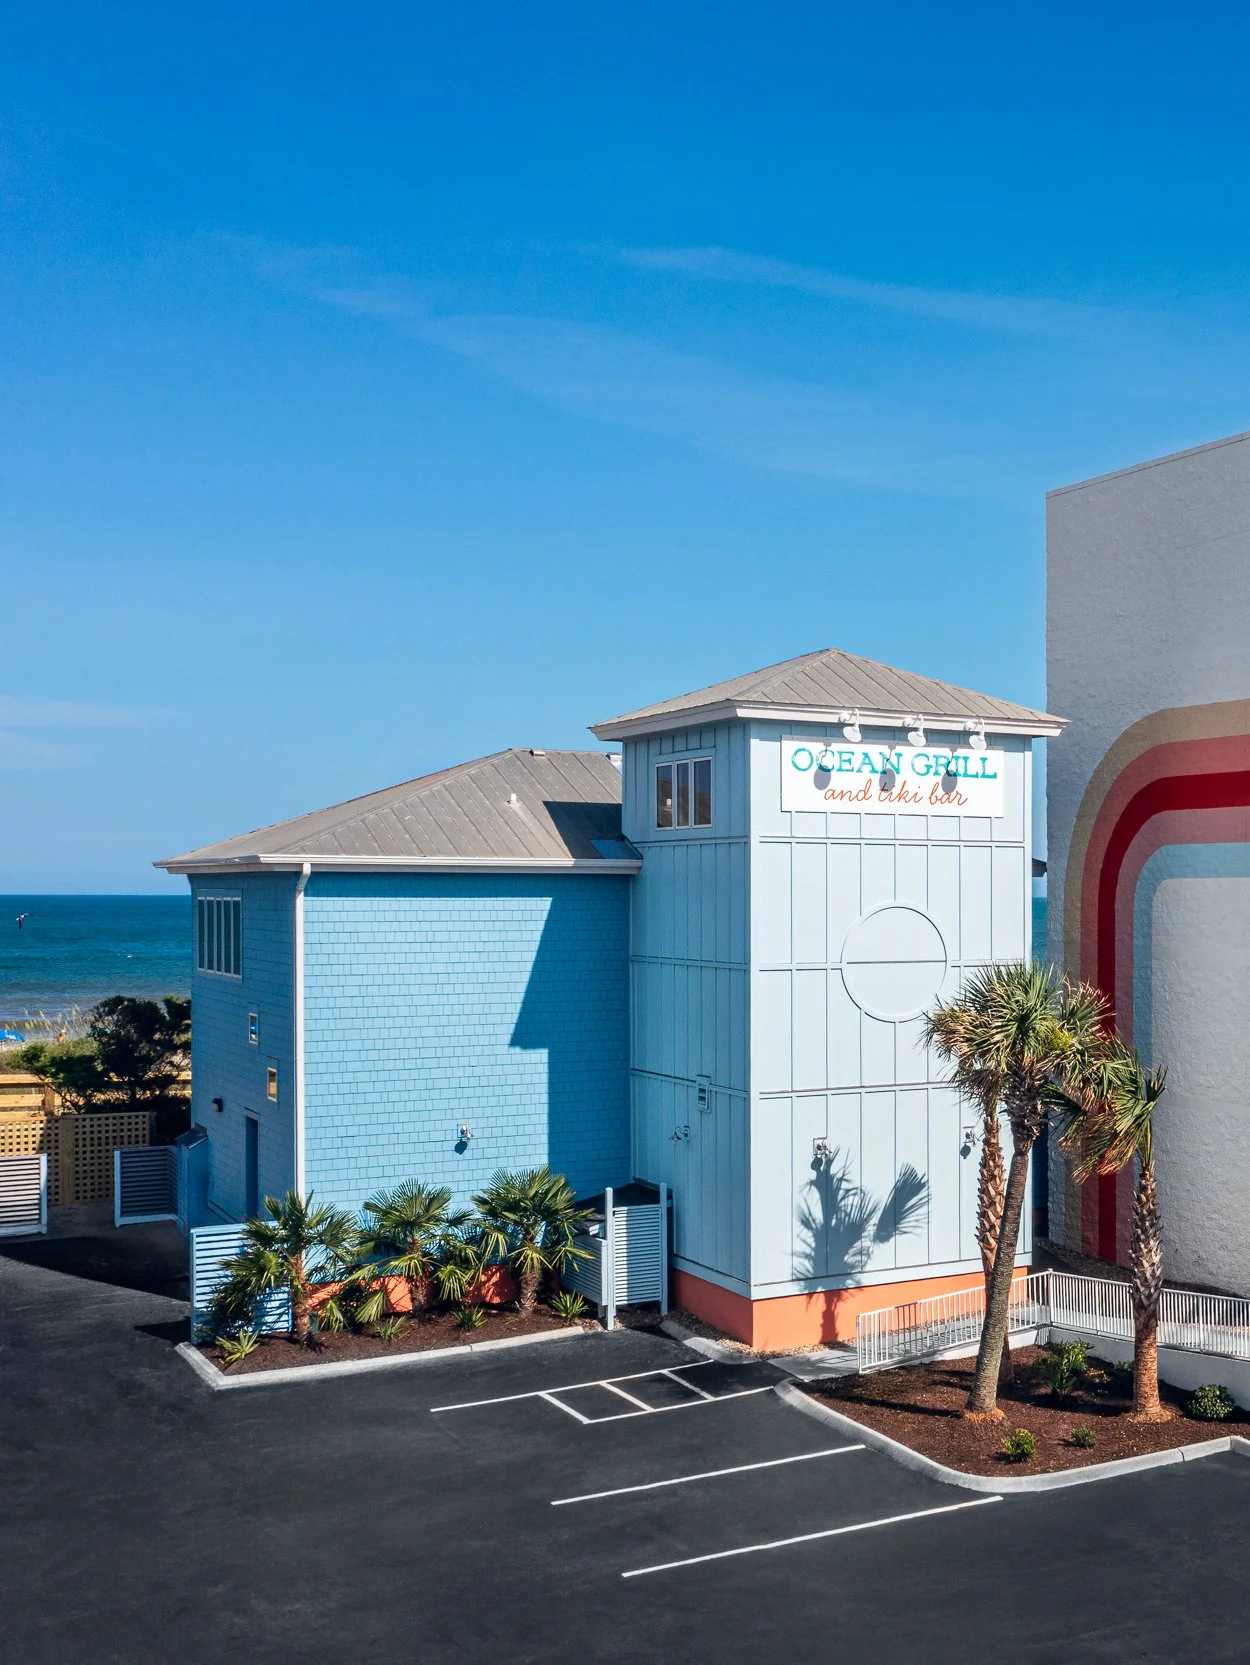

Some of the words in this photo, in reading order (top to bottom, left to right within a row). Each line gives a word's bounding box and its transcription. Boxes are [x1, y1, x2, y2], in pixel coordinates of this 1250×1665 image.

[791, 748, 902, 775] OCEAN
[910, 753, 998, 779] GRILL
[823, 778, 873, 802] and
[877, 780, 923, 803] tiki
[928, 781, 968, 806] bar
